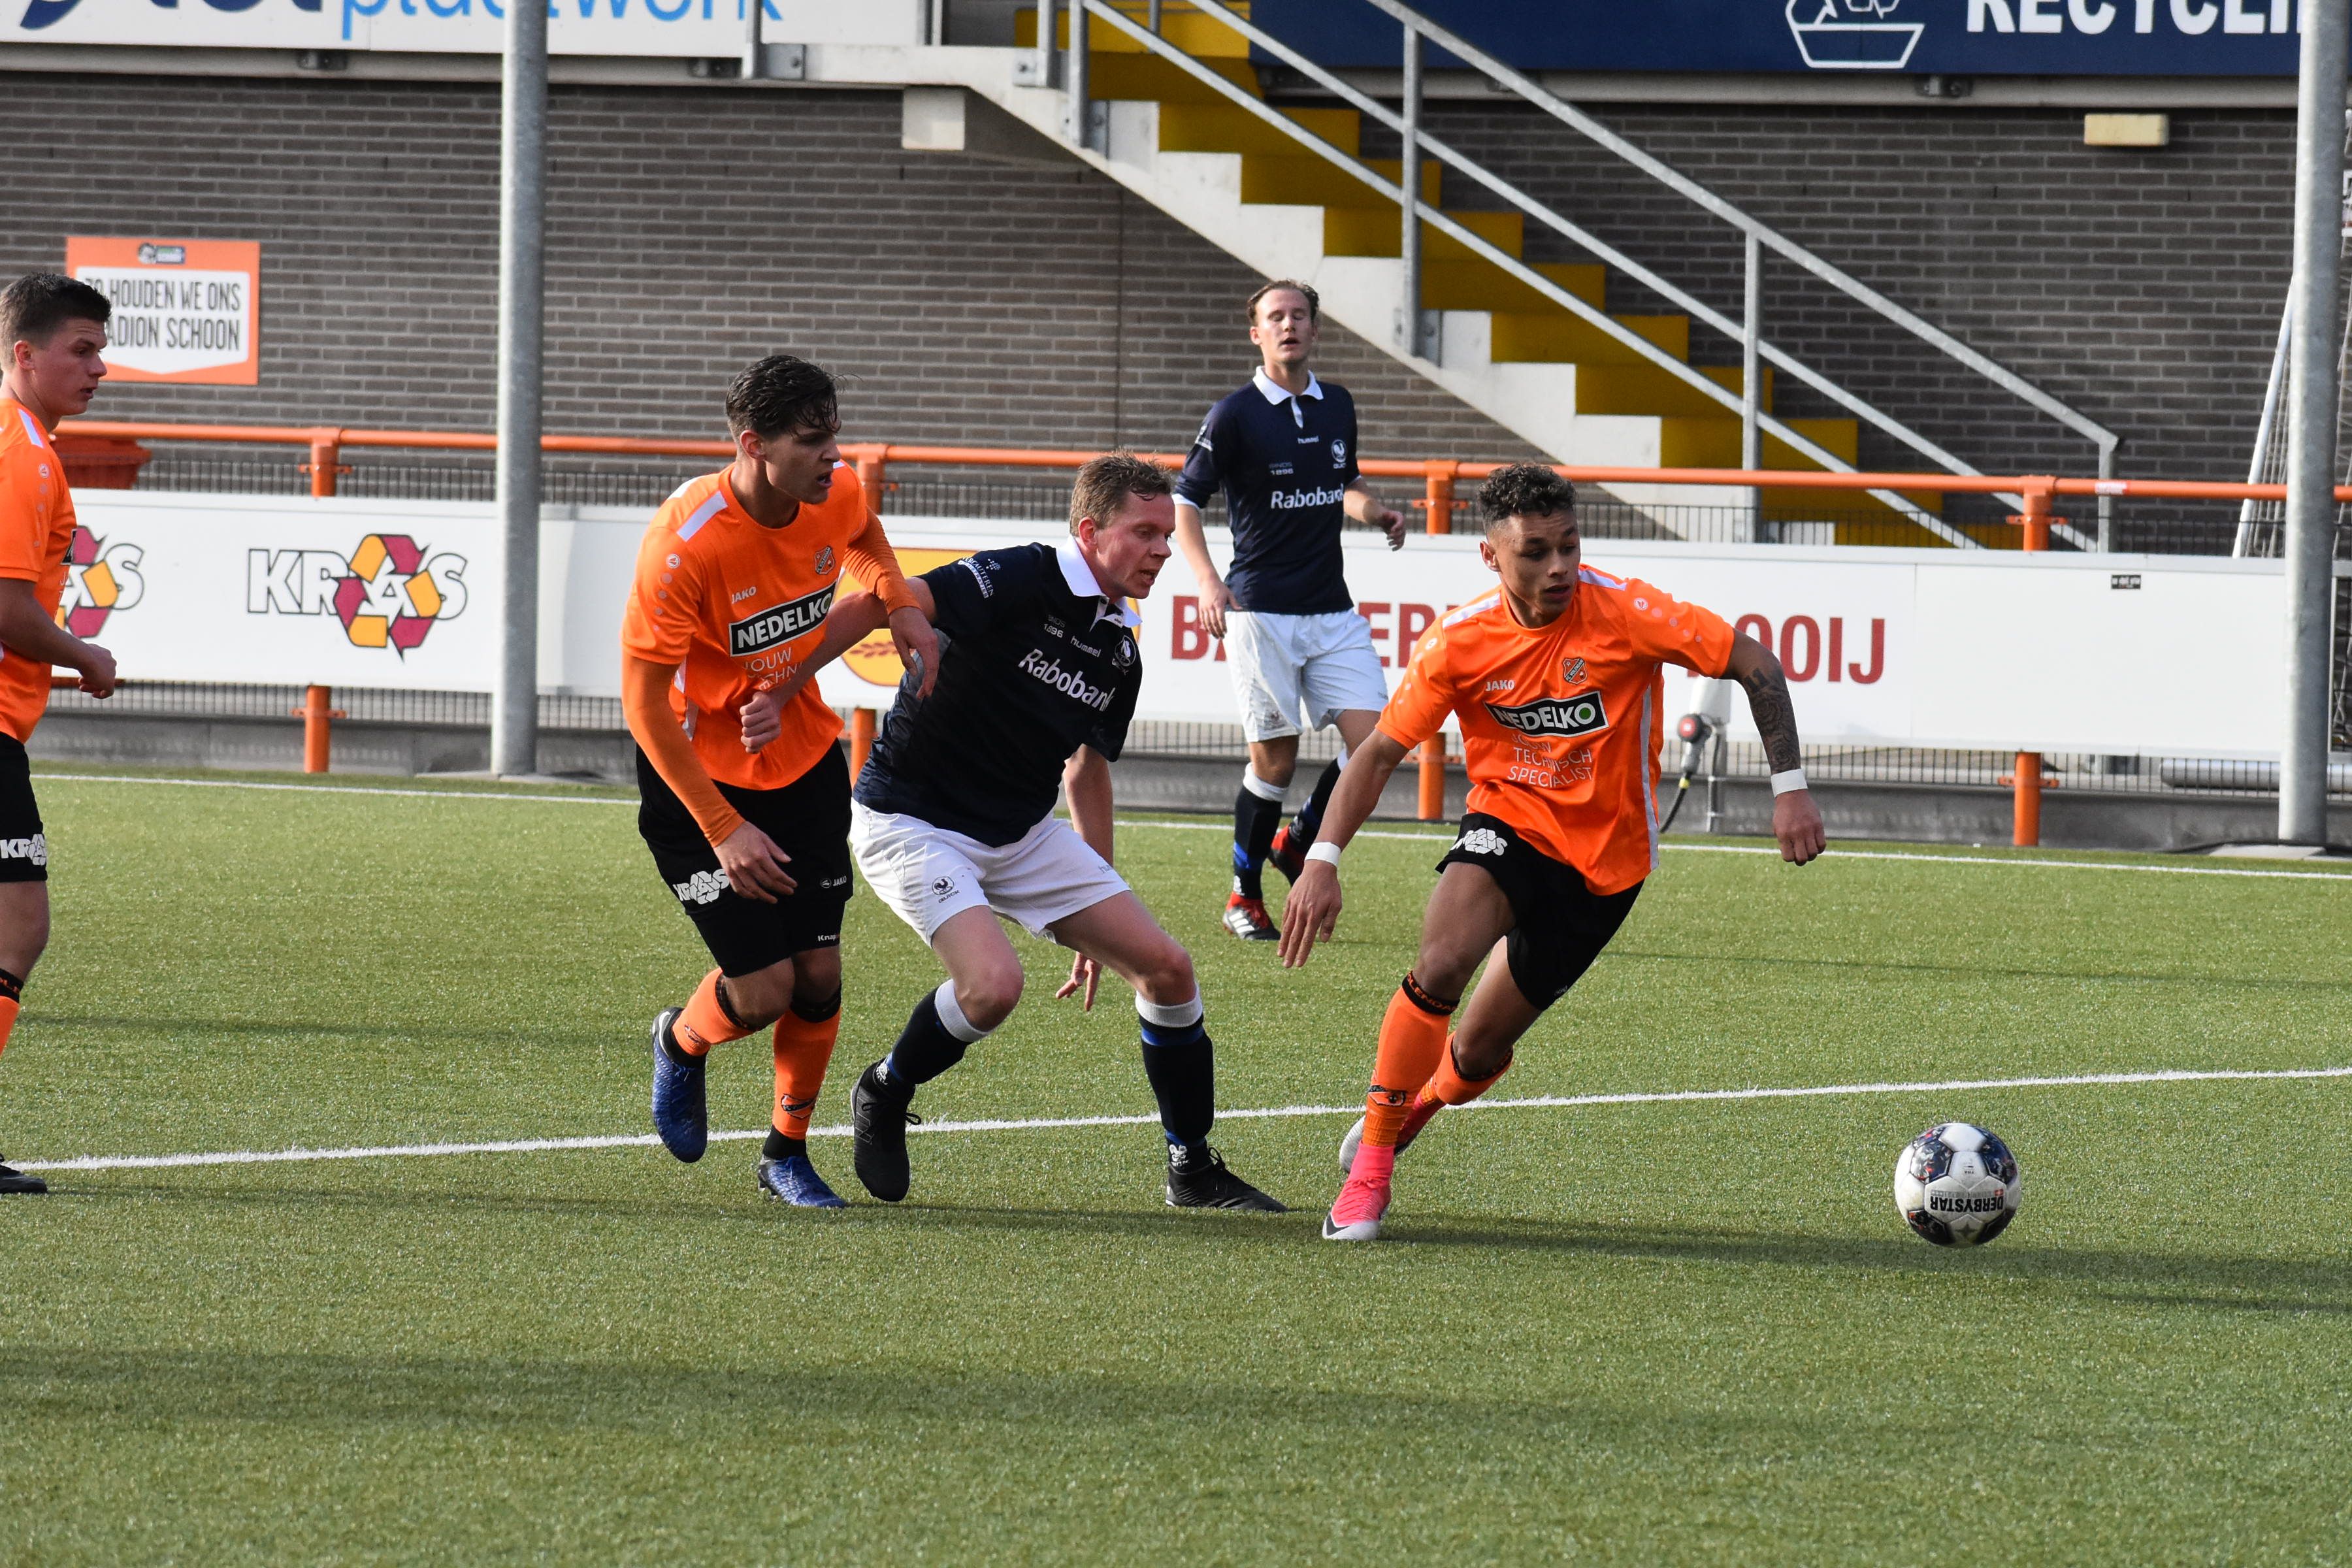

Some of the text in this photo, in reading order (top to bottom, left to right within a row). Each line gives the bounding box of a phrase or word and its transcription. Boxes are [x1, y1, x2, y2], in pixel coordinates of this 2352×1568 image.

[110, 279, 174, 310] HOUDEN
[180, 281, 203, 310] WE
[208, 282, 240, 311] ONS
[106, 316, 240, 351] ADION SCHOON
[1271, 483, 1344, 509] Rabobank
[248, 548, 468, 620] KRAS
[731, 586, 757, 604] JAKO
[737, 593, 832, 649] NEDELKO
[1043, 623, 1064, 638] 1896
[1070, 636, 1102, 658] hummel
[1018, 648, 1116, 711] Rabobank
[1485, 679, 1515, 692] JAKO
[1493, 702, 1596, 730] NEDELKO
[1513, 747, 1592, 773] TECHNISCH
[1507, 766, 1593, 788] SPECIALIST
[832, 875, 847, 887] JAKO
[1930, 1196, 2004, 1213] DERBYSTAR
